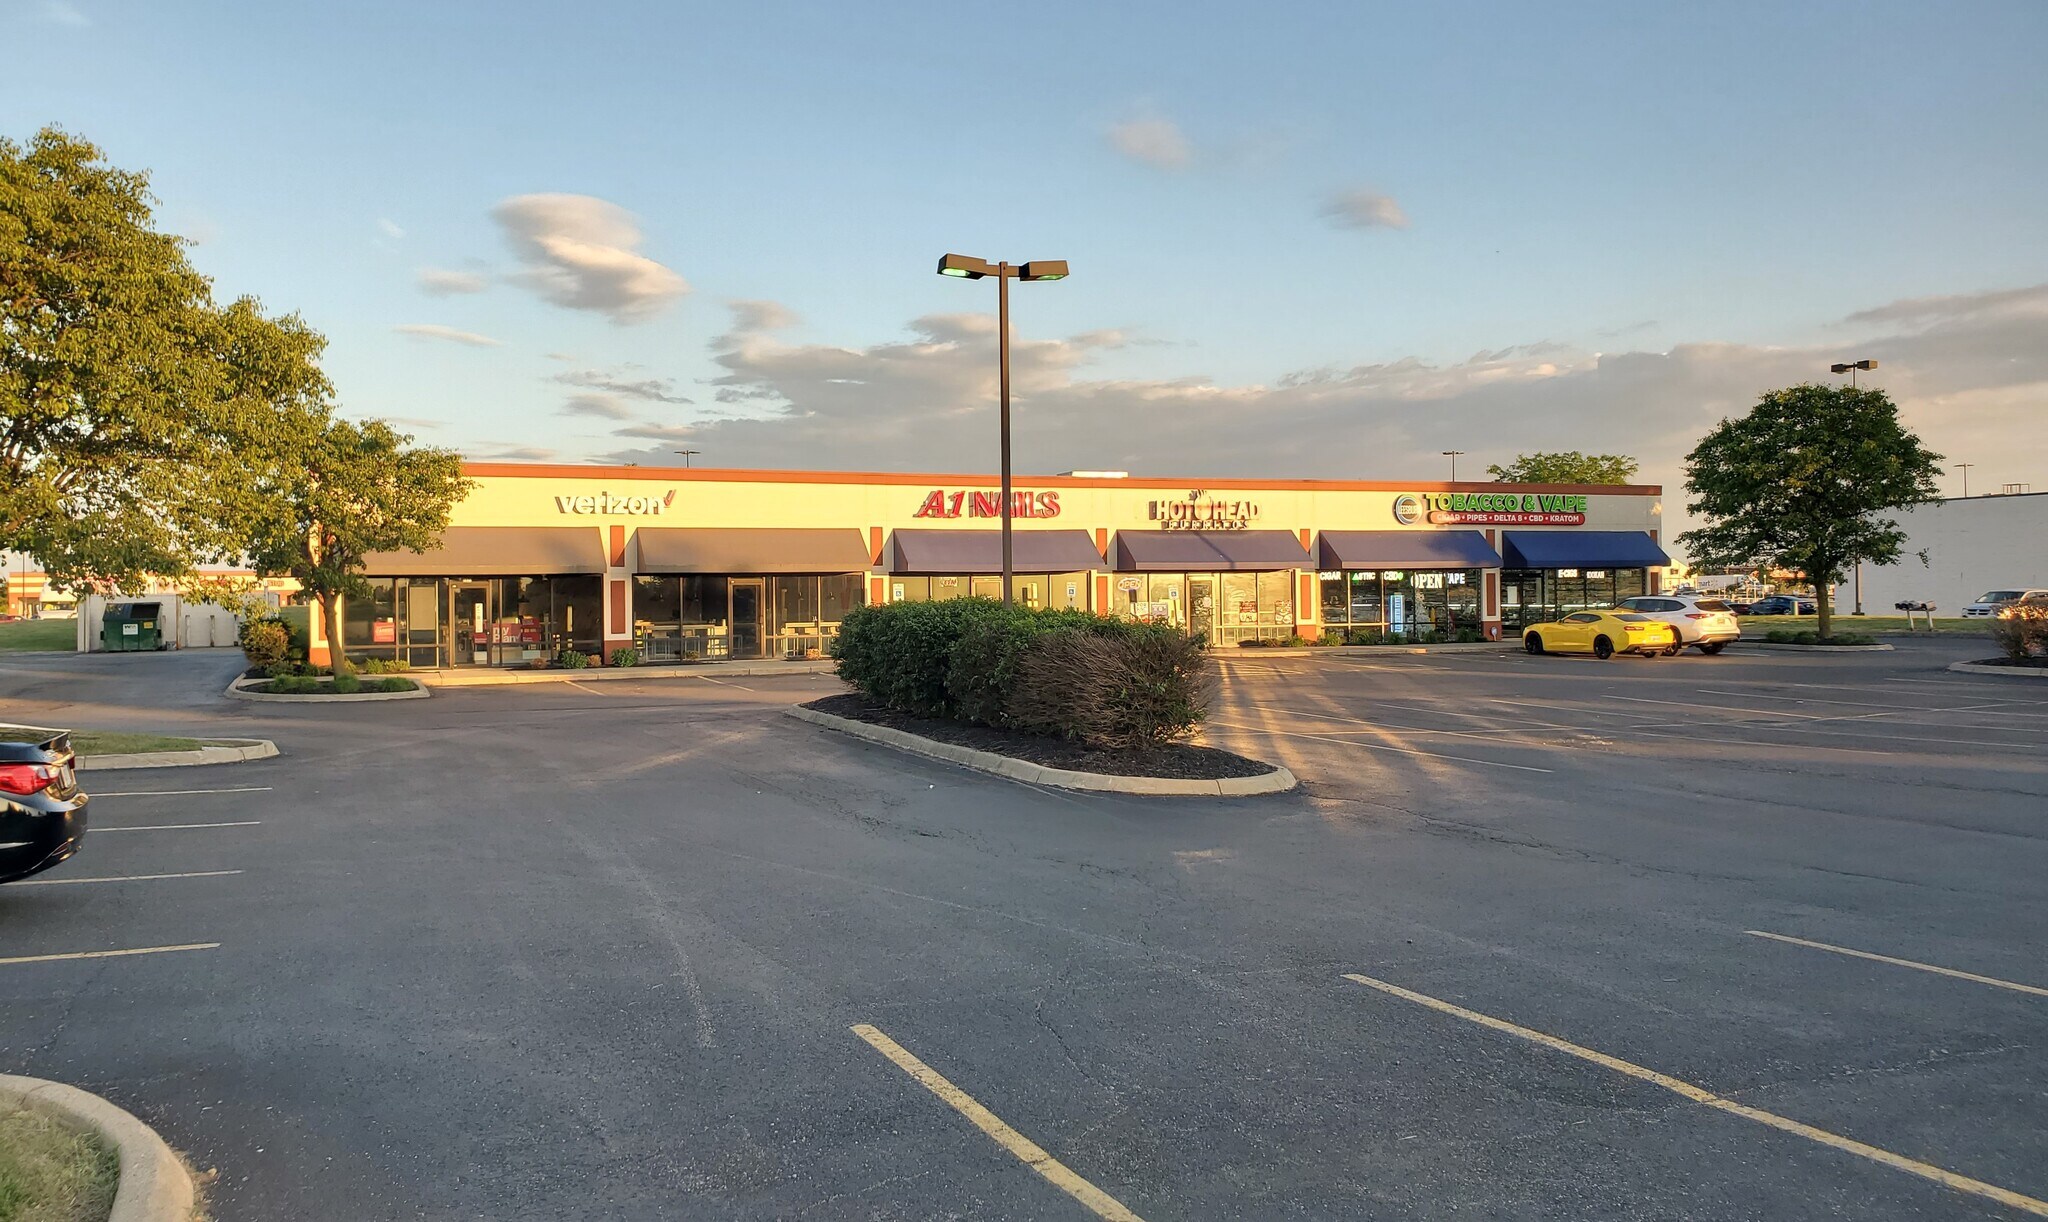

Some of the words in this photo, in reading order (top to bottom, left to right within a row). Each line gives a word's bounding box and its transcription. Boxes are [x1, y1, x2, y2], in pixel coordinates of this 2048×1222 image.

[555, 491, 665, 515] verizon
[914, 490, 965, 518] A1
[969, 491, 1061, 518] NAILS
[1150, 501, 1194, 520] HOT
[1212, 501, 1261, 520] HEAD
[1398, 505, 1420, 514] LEESBUR
[1424, 494, 1518, 512] TOBACCO
[1522, 494, 1536, 512] &
[1539, 495, 1587, 513] VAPE
[1162, 520, 1249, 530] BURRITOS
[1319, 571, 1341, 580] CIGAR
[1411, 573, 1443, 589] OPEN
